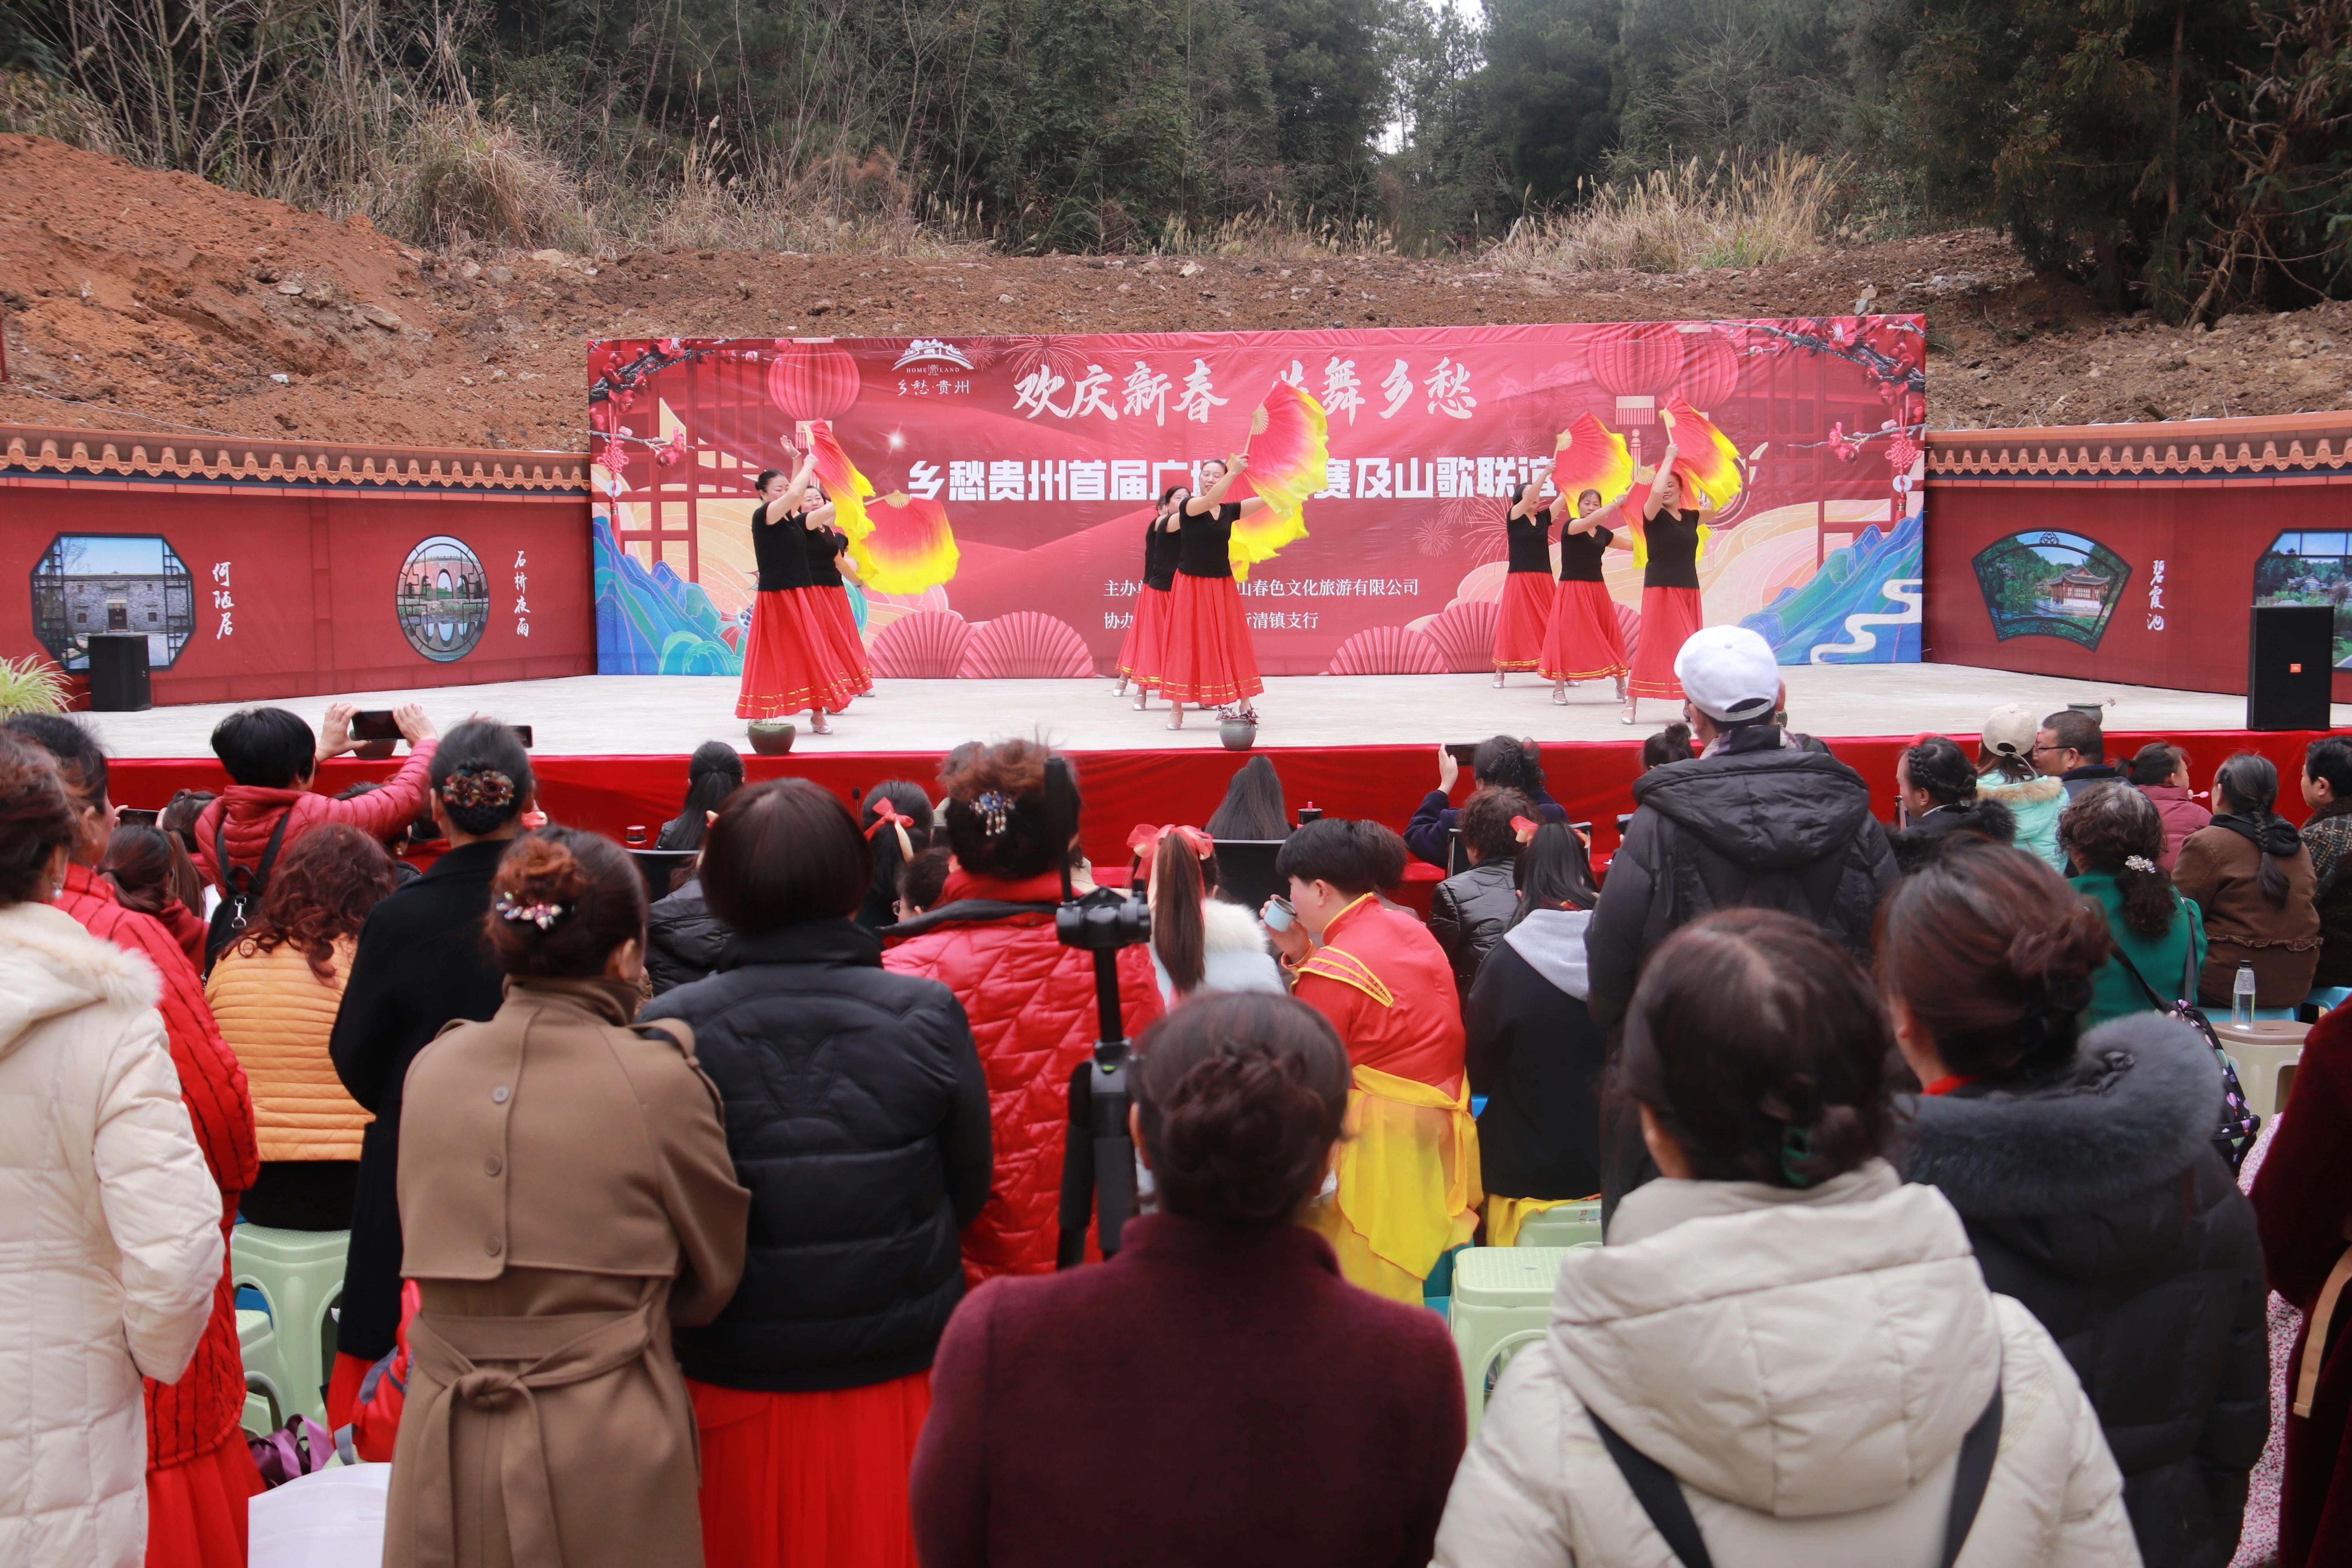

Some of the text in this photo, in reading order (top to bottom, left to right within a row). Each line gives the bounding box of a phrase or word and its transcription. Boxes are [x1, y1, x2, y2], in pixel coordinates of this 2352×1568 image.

[1013, 358, 1229, 426] 欢庆新春
[212, 561, 235, 640] 何陋居
[514, 550, 531, 637] 石桥夜雨
[2147, 560, 2165, 631] 碧霞池
